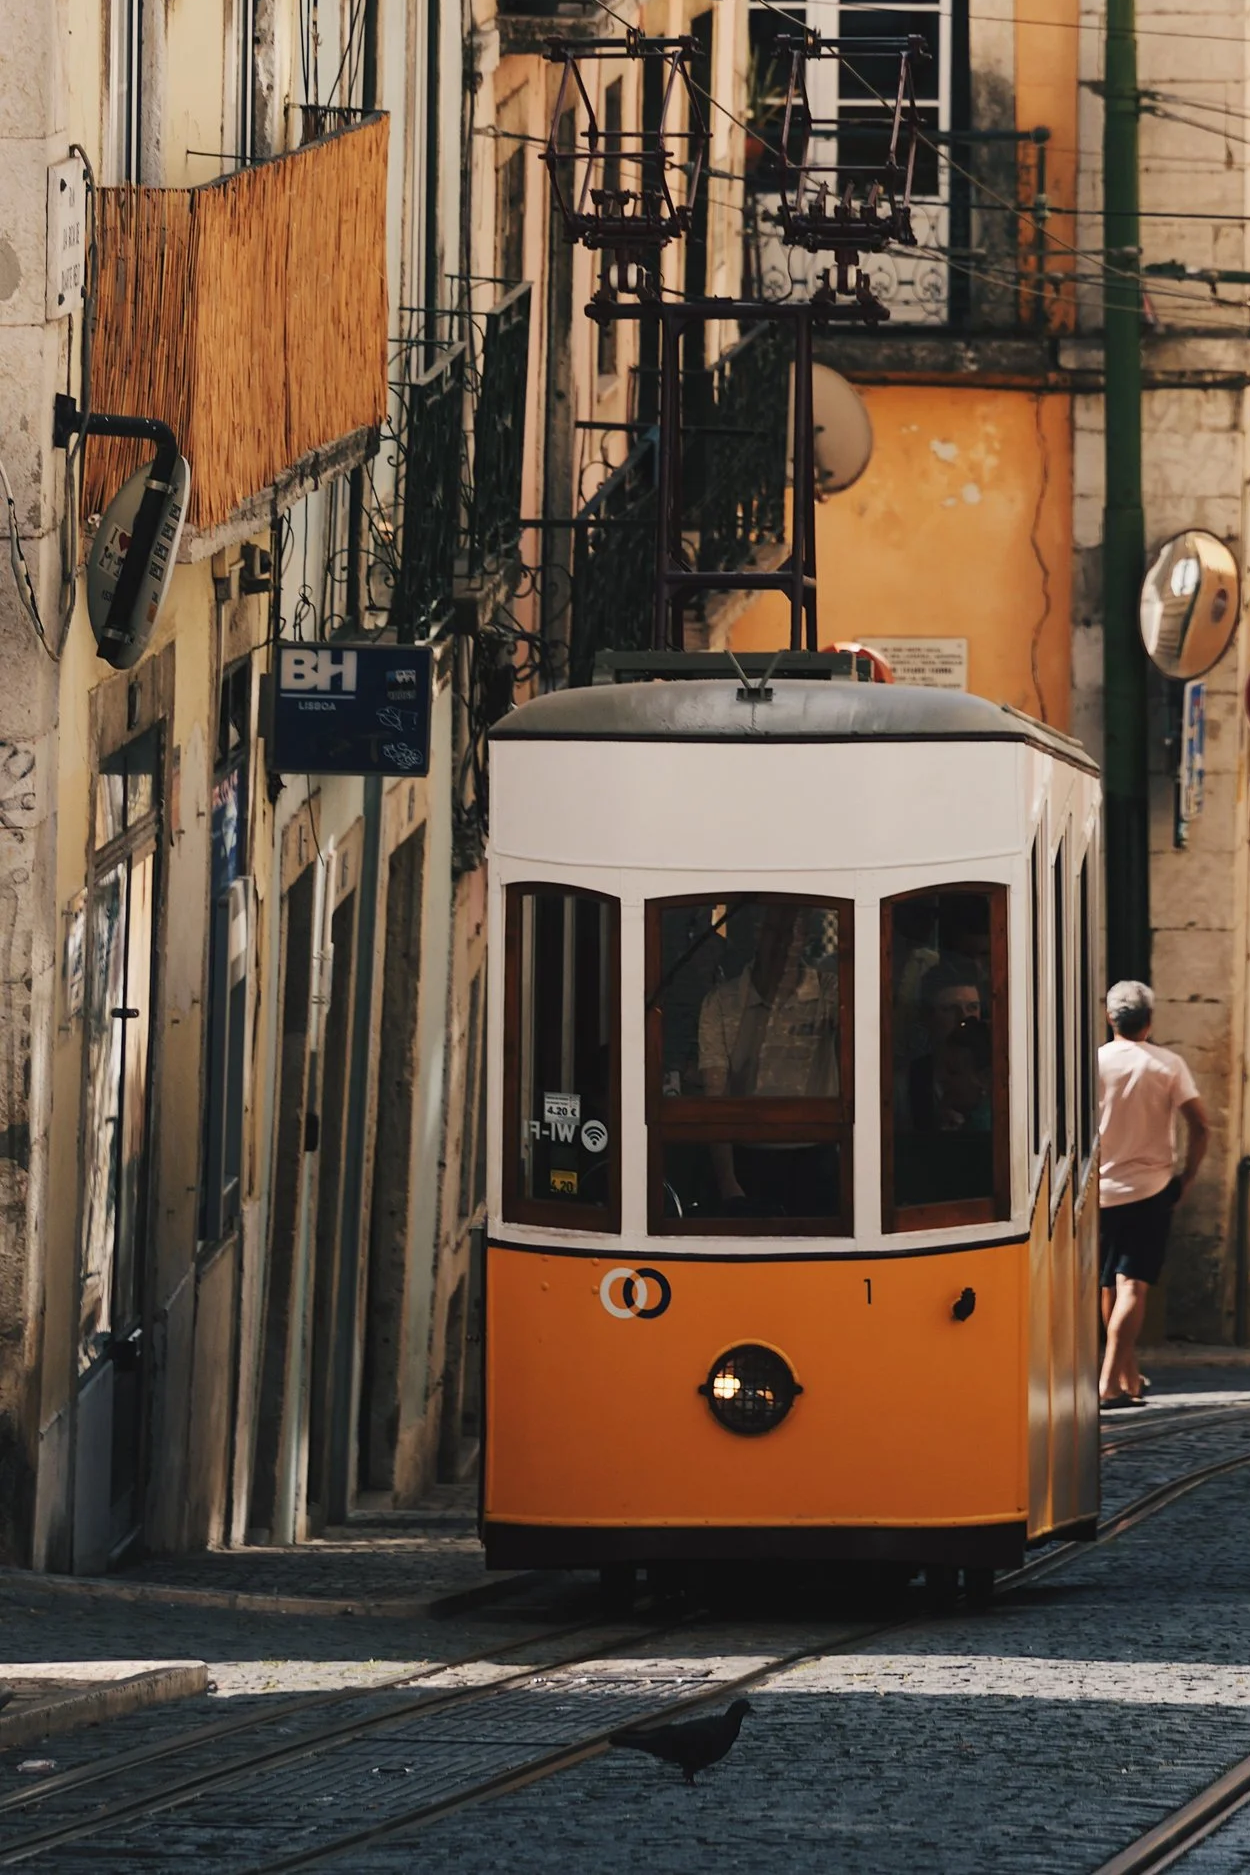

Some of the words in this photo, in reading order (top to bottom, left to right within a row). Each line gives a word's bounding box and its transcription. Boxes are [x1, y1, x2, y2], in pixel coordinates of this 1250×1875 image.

[280, 648, 358, 692] BH
[298, 701, 337, 712] LISBOA
[546, 1105, 568, 1116] 4.20
[863, 1278, 872, 1305] 1
